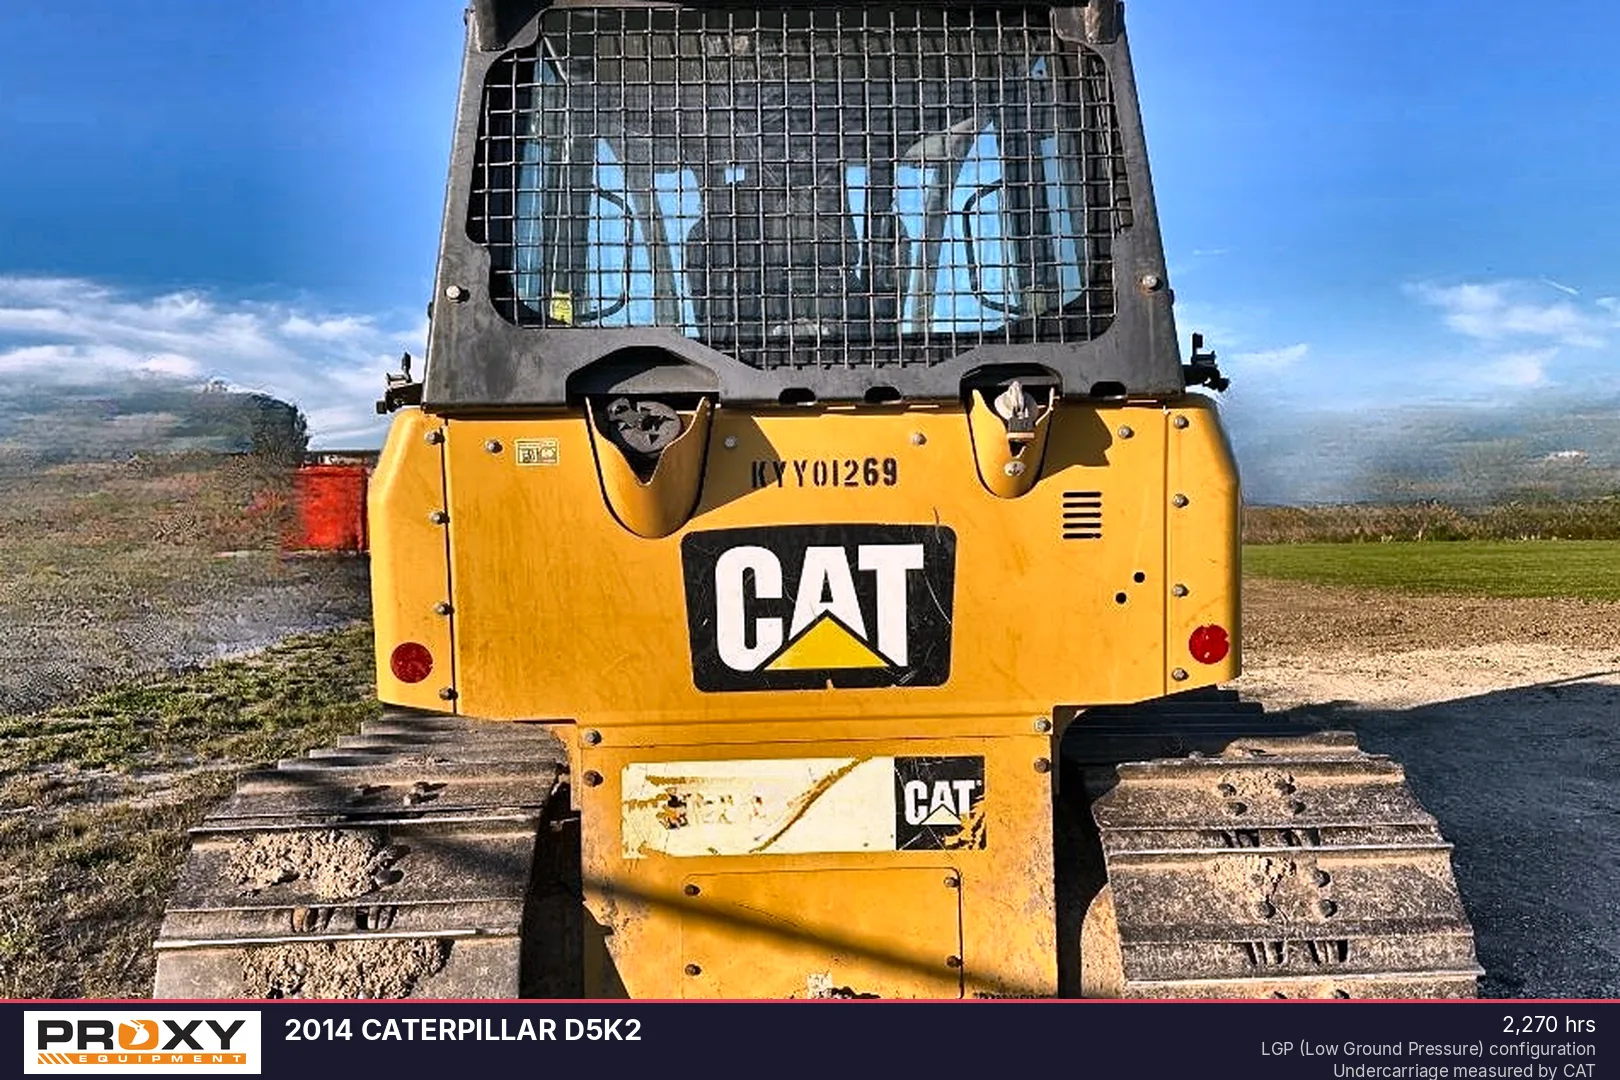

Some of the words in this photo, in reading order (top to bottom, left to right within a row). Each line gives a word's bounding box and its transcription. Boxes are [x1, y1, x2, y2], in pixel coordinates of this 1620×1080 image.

[751, 458, 898, 488] KYY01269
[714, 544, 924, 672] CAT
[904, 779, 976, 825] CAT
